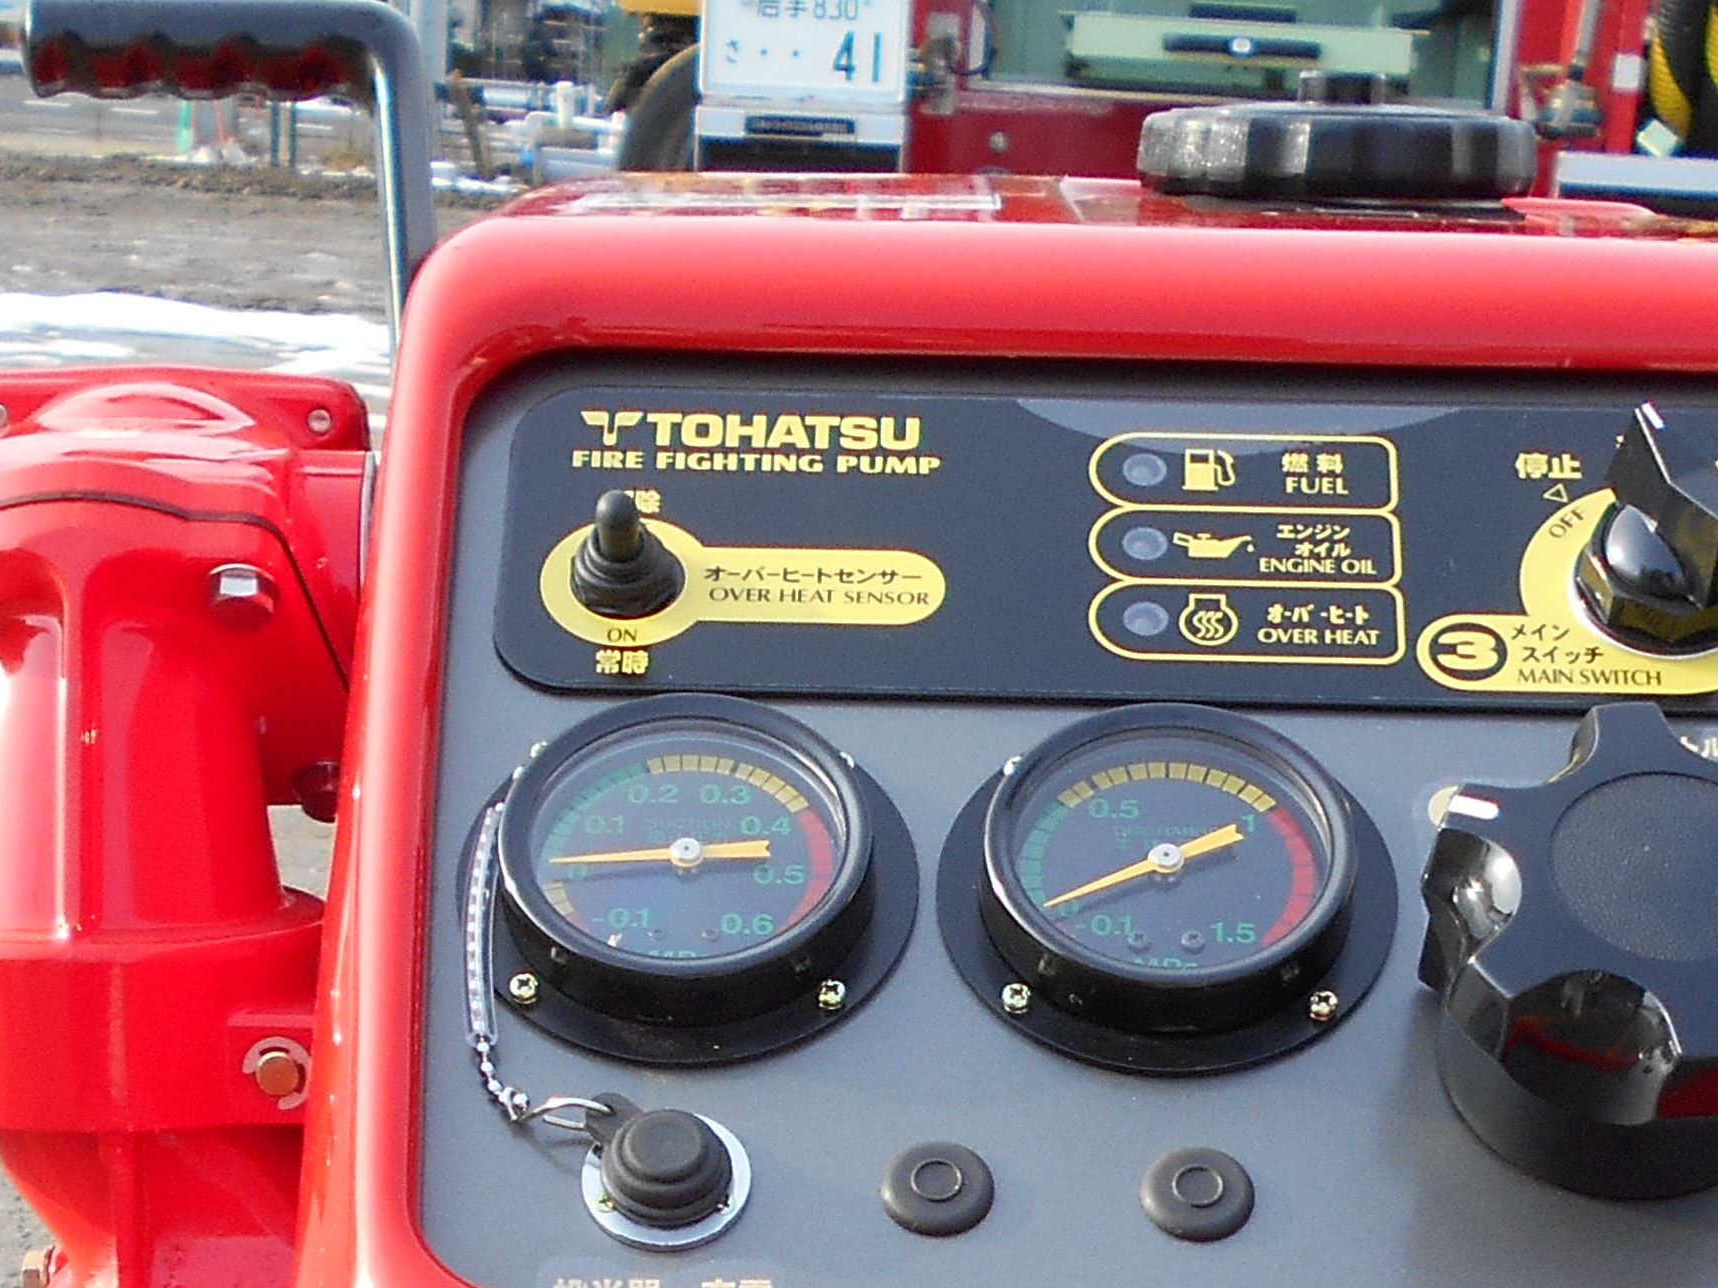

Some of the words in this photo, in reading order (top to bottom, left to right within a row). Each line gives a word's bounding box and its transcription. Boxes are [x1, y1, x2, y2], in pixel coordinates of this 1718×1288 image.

[647, 411, 920, 450] TOHATSU
[572, 450, 644, 469] FIRE
[656, 452, 824, 474] FIGHTING
[837, 455, 941, 475] PUMP
[1515, 452, 1582, 480] 停止
[1285, 477, 1349, 494] FUEL
[1276, 524, 1351, 540] エンジン
[1548, 507, 1586, 539] OFF
[1295, 541, 1351, 557] オイル
[704, 566, 921, 584] オーバーヒートセンサー
[1259, 557, 1336, 574] ENGINE
[1341, 559, 1377, 575] OIL
[709, 587, 771, 603] OVER
[780, 588, 834, 604] HEAT
[844, 590, 929, 606] SENSOR
[607, 628, 638, 643] ON
[1257, 628, 1318, 644] OVER
[1324, 629, 1380, 645] HEAT
[1511, 623, 1570, 640] メイン
[1437, 631, 1499, 671] 3
[1522, 645, 1603, 664] スイッチ
[595, 650, 649, 675] 常時
[1517, 668, 1573, 684] MAIN
[1579, 670, 1661, 686] SWITCH
[628, 784, 679, 803] 0.2
[699, 784, 751, 804] 0.3
[1089, 799, 1140, 819] 0.5
[585, 814, 625, 834] 0.1
[741, 815, 791, 835] 0.4
[1242, 813, 1257, 833] 1
[753, 865, 805, 884] 0.5
[720, 914, 774, 934] 0.6
[1211, 921, 1257, 943] 1.5
